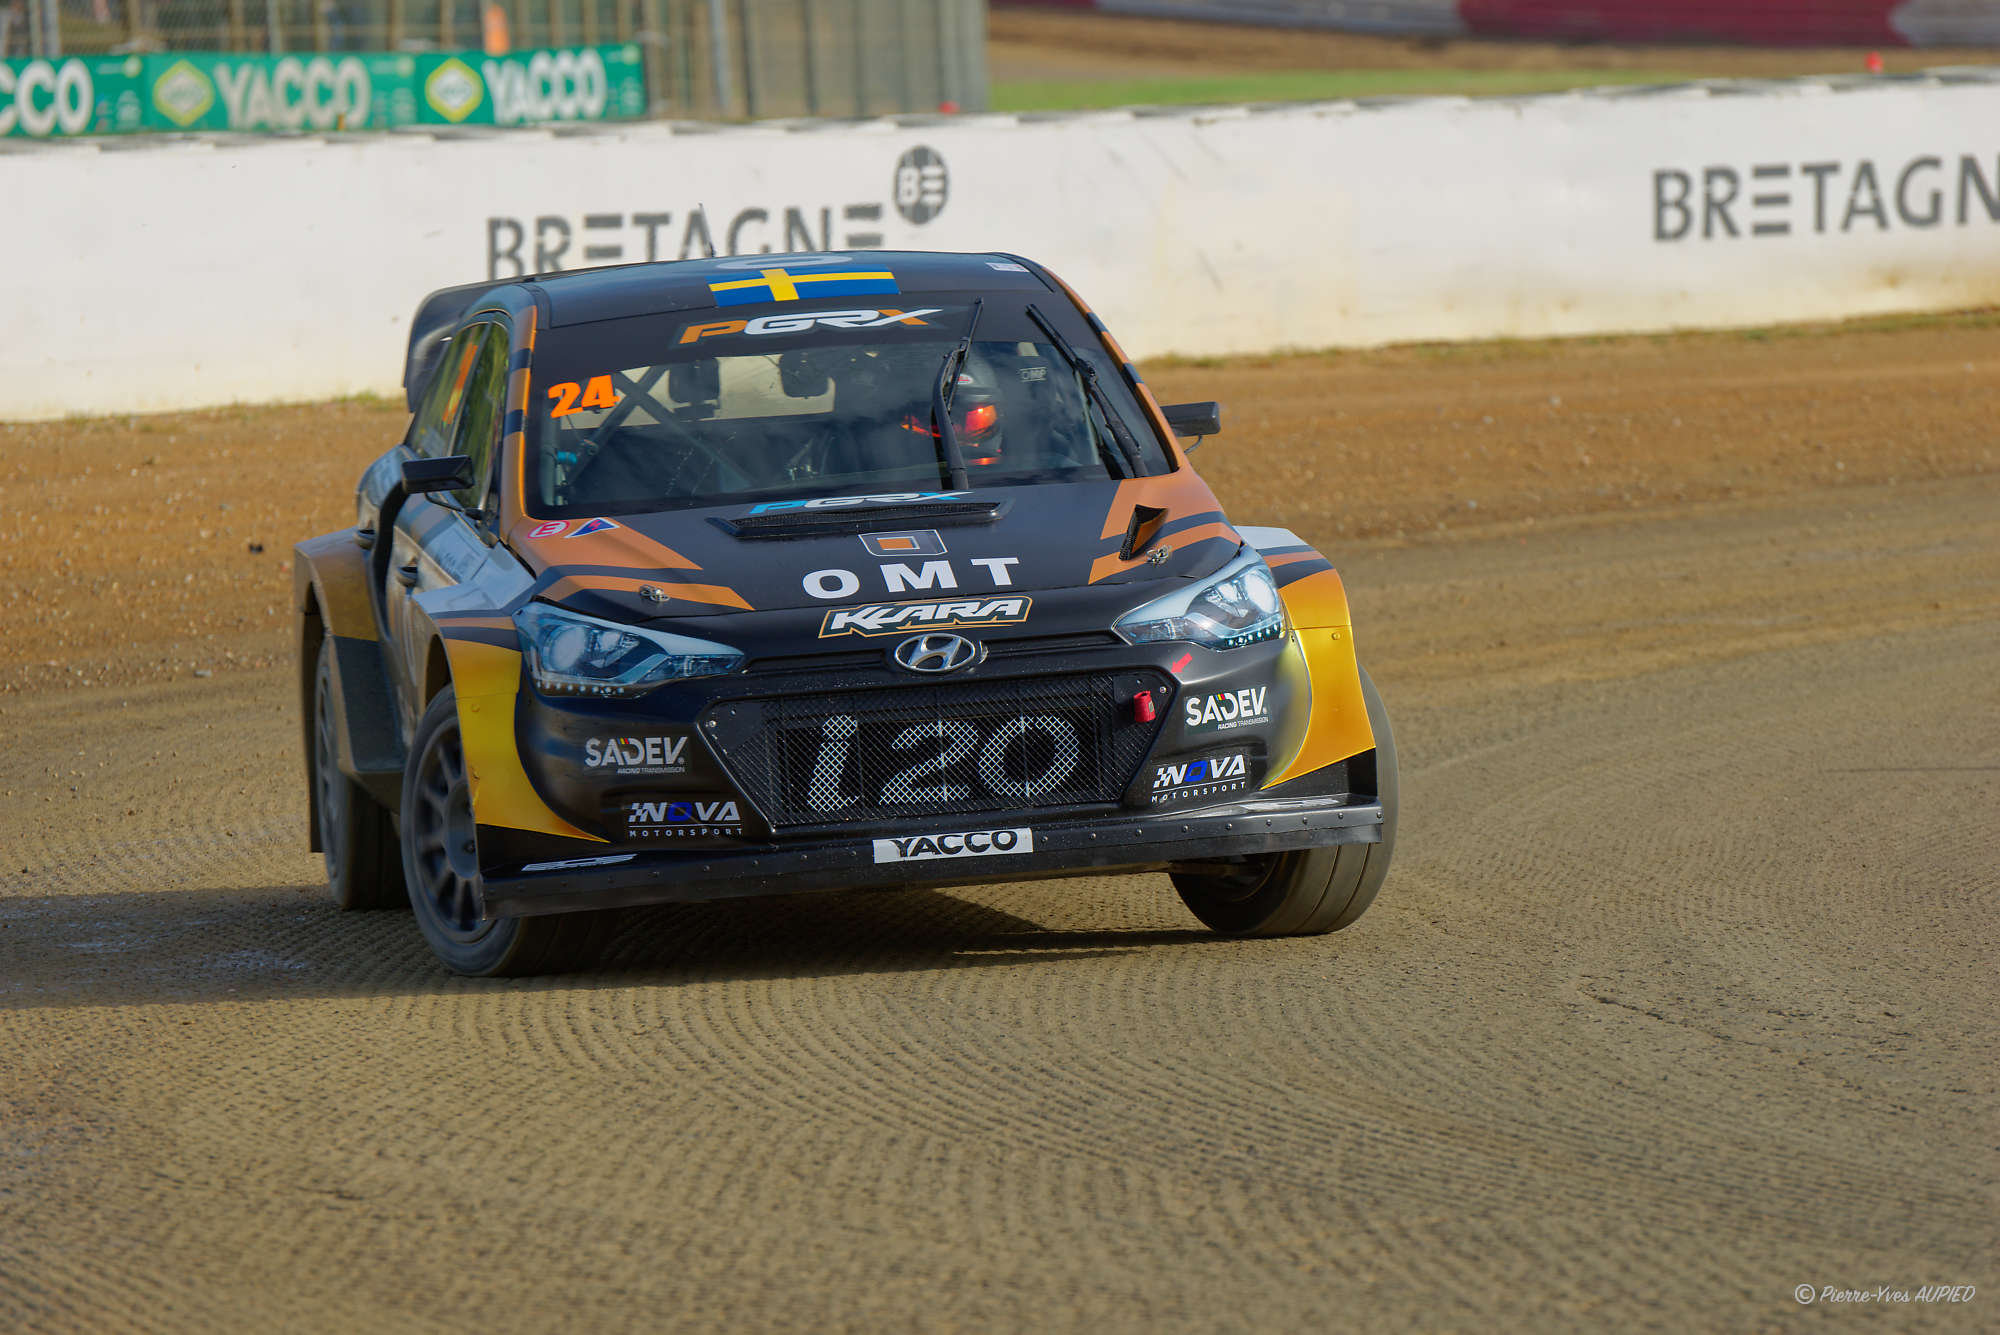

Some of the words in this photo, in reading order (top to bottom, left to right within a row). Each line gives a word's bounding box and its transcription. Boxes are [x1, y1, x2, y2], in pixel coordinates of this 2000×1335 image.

[213, 56, 371, 129] YACCO
[481, 48, 607, 125] YACCO
[1652, 153, 2000, 242] BRETAGN
[487, 203, 882, 280] BRETAGNE
[679, 309, 943, 344] PGRX
[547, 375, 620, 418] 24
[749, 491, 974, 514] PGRX
[802, 557, 1020, 599] OMT
[1186, 687, 1267, 726] SADEV
[584, 736, 688, 767] SADEV
[1151, 781, 1246, 803] MOTORSPORT
[629, 828, 743, 837] MOTORSPORT
[890, 830, 1018, 857] YACCO
